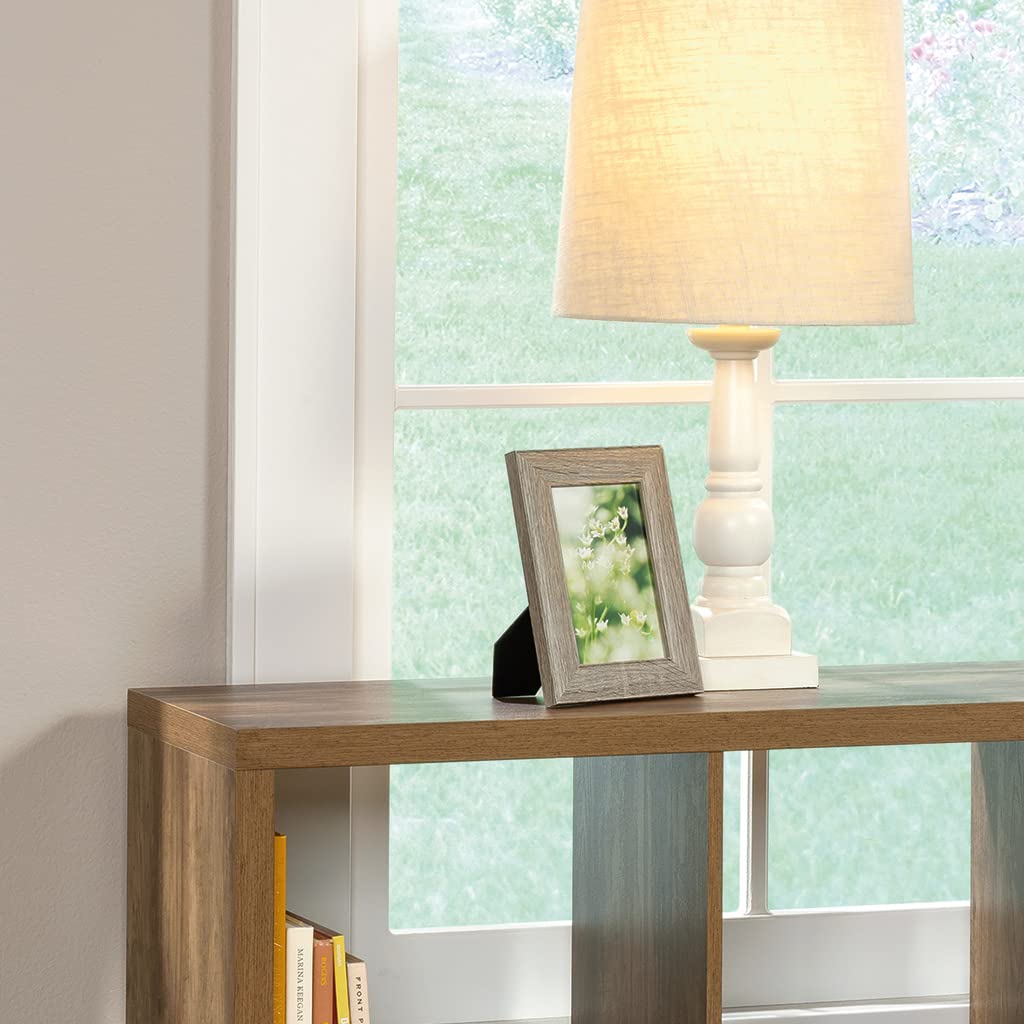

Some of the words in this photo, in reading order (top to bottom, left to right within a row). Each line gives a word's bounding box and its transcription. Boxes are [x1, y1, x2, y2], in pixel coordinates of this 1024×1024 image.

[296, 949, 304, 984] MARINA
[296, 985, 304, 1022] KEEGAN
[354, 976, 364, 1013] FRONT
